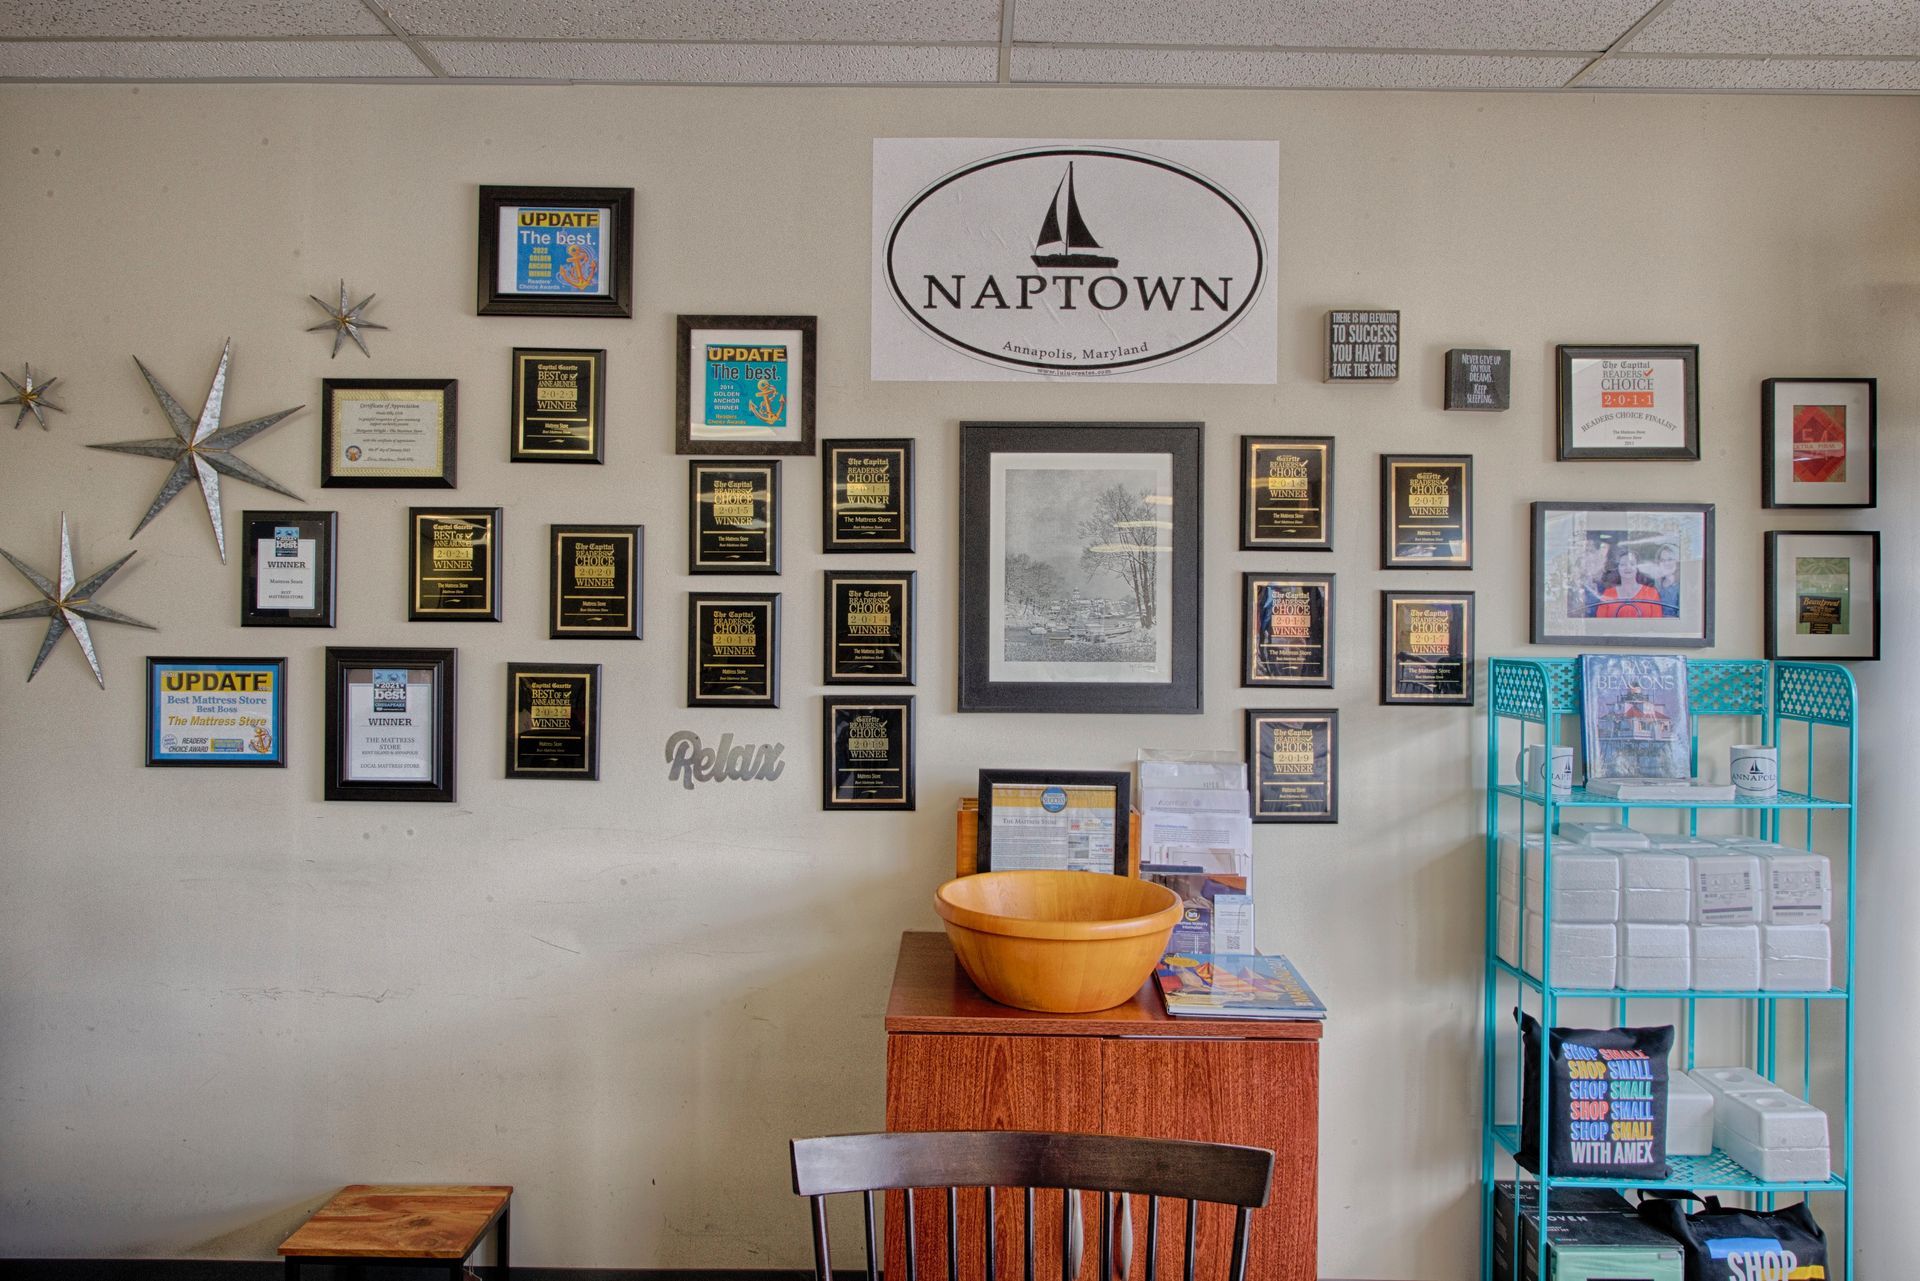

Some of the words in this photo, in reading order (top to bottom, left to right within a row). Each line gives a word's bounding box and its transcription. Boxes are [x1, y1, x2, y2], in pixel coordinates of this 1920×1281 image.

[521, 212, 598, 227] UPDATE
[519, 230, 551, 245] The
[556, 231, 596, 245] best.
[923, 274, 1233, 312] NAPTOWN
[1332, 312, 1351, 323] THERE
[1352, 313, 1359, 323] IS
[1359, 313, 1369, 323] NO
[1369, 313, 1397, 323] ELEVATOR
[1332, 324, 1346, 343] TO
[1348, 325, 1397, 343] SUCCESS
[708, 347, 785, 362] UPDATE
[1002, 341, 1077, 361] Annapolis,
[1082, 342, 1149, 361] Maryland
[1332, 344, 1352, 362] YOU
[1355, 344, 1381, 362] HAVE
[1385, 344, 1397, 362] TO
[1461, 353, 1479, 365] NEVER
[1480, 355, 1493, 365] GIVE
[1493, 355, 1501, 365] UP
[1332, 363, 1352, 377] TAKE
[1353, 363, 1368, 377] THE
[1369, 363, 1397, 377] STAIRS
[1470, 364, 1478, 373] ON
[1479, 364, 1491, 373] YOUR
[1602, 361, 1618, 369] The
[1620, 361, 1650, 369] Capital
[538, 371, 560, 381] BEST
[711, 363, 739, 380] The
[745, 363, 781, 380] best.
[1473, 383, 1488, 395] KEEP
[1601, 379, 1654, 390] CHOICE
[537, 400, 577, 410] WINNER
[1580, 414, 1614, 432] READERS
[1645, 414, 1678, 432] FINALIST
[863, 458, 889, 466] Capital
[1269, 467, 1308, 478] CHOICE
[846, 473, 890, 483] CHOICE
[713, 480, 727, 488] The
[1270, 490, 1308, 498] WINNER
[1410, 485, 1448, 495] CHOICE
[714, 493, 753, 504] CHOICE
[847, 495, 889, 504] WINNER
[1410, 507, 1448, 515] WINNER
[714, 517, 753, 526] WINNER
[433, 531, 456, 540] BEST
[575, 542, 587, 550] The
[589, 543, 614, 551] Capital
[433, 560, 473, 569] WINNER
[575, 557, 615, 566] CHOICE
[575, 578, 614, 587] WINNER
[1285, 592, 1310, 600] Capital
[848, 604, 890, 613] CHOICE
[1272, 605, 1310, 615] CHOICE
[728, 611, 753, 619] Capital
[714, 624, 755, 634] CHOICE
[849, 625, 890, 634] WINNER
[1271, 627, 1310, 636] WINNER
[1411, 622, 1449, 633] CHOICE
[713, 646, 755, 655] WINNER
[1411, 645, 1448, 654] WINNER
[1621, 660, 1651, 675] BAY
[166, 671, 268, 692] UPDATE
[1597, 676, 1674, 689] BEACONS
[374, 689, 406, 700] best
[532, 689, 555, 699] BEST
[167, 695, 189, 704] Best
[191, 695, 237, 704] Mattress
[238, 695, 267, 705] Store
[168, 715, 188, 726] The
[190, 715, 236, 726] Mattress
[239, 716, 267, 726] Store
[368, 718, 412, 726] WINNER
[531, 719, 570, 728] WINNER
[849, 728, 887, 738] CHOICE
[181, 737, 209, 745] READERS'
[1274, 742, 1313, 752] CHOICE
[850, 750, 888, 758] WINNER
[665, 730, 786, 790] Relax
[1274, 764, 1313, 773] WINNER
[1562, 1042, 1598, 1060] SHOP
[1598, 1048, 1650, 1060] SMALL
[1567, 1060, 1607, 1079] SHOP
[1607, 1060, 1654, 1079] SMALL
[1569, 1080, 1608, 1099] SHOP
[1610, 1081, 1654, 1100] SMALL
[1570, 1100, 1609, 1120] SHOP
[1610, 1101, 1654, 1120] SMALL
[1570, 1121, 1609, 1141] SHOP
[1611, 1121, 1654, 1141] SMALL
[1570, 1141, 1612, 1164] WITH
[1613, 1141, 1654, 1164] AMEX
[1727, 1250, 1798, 1281] SHOP
